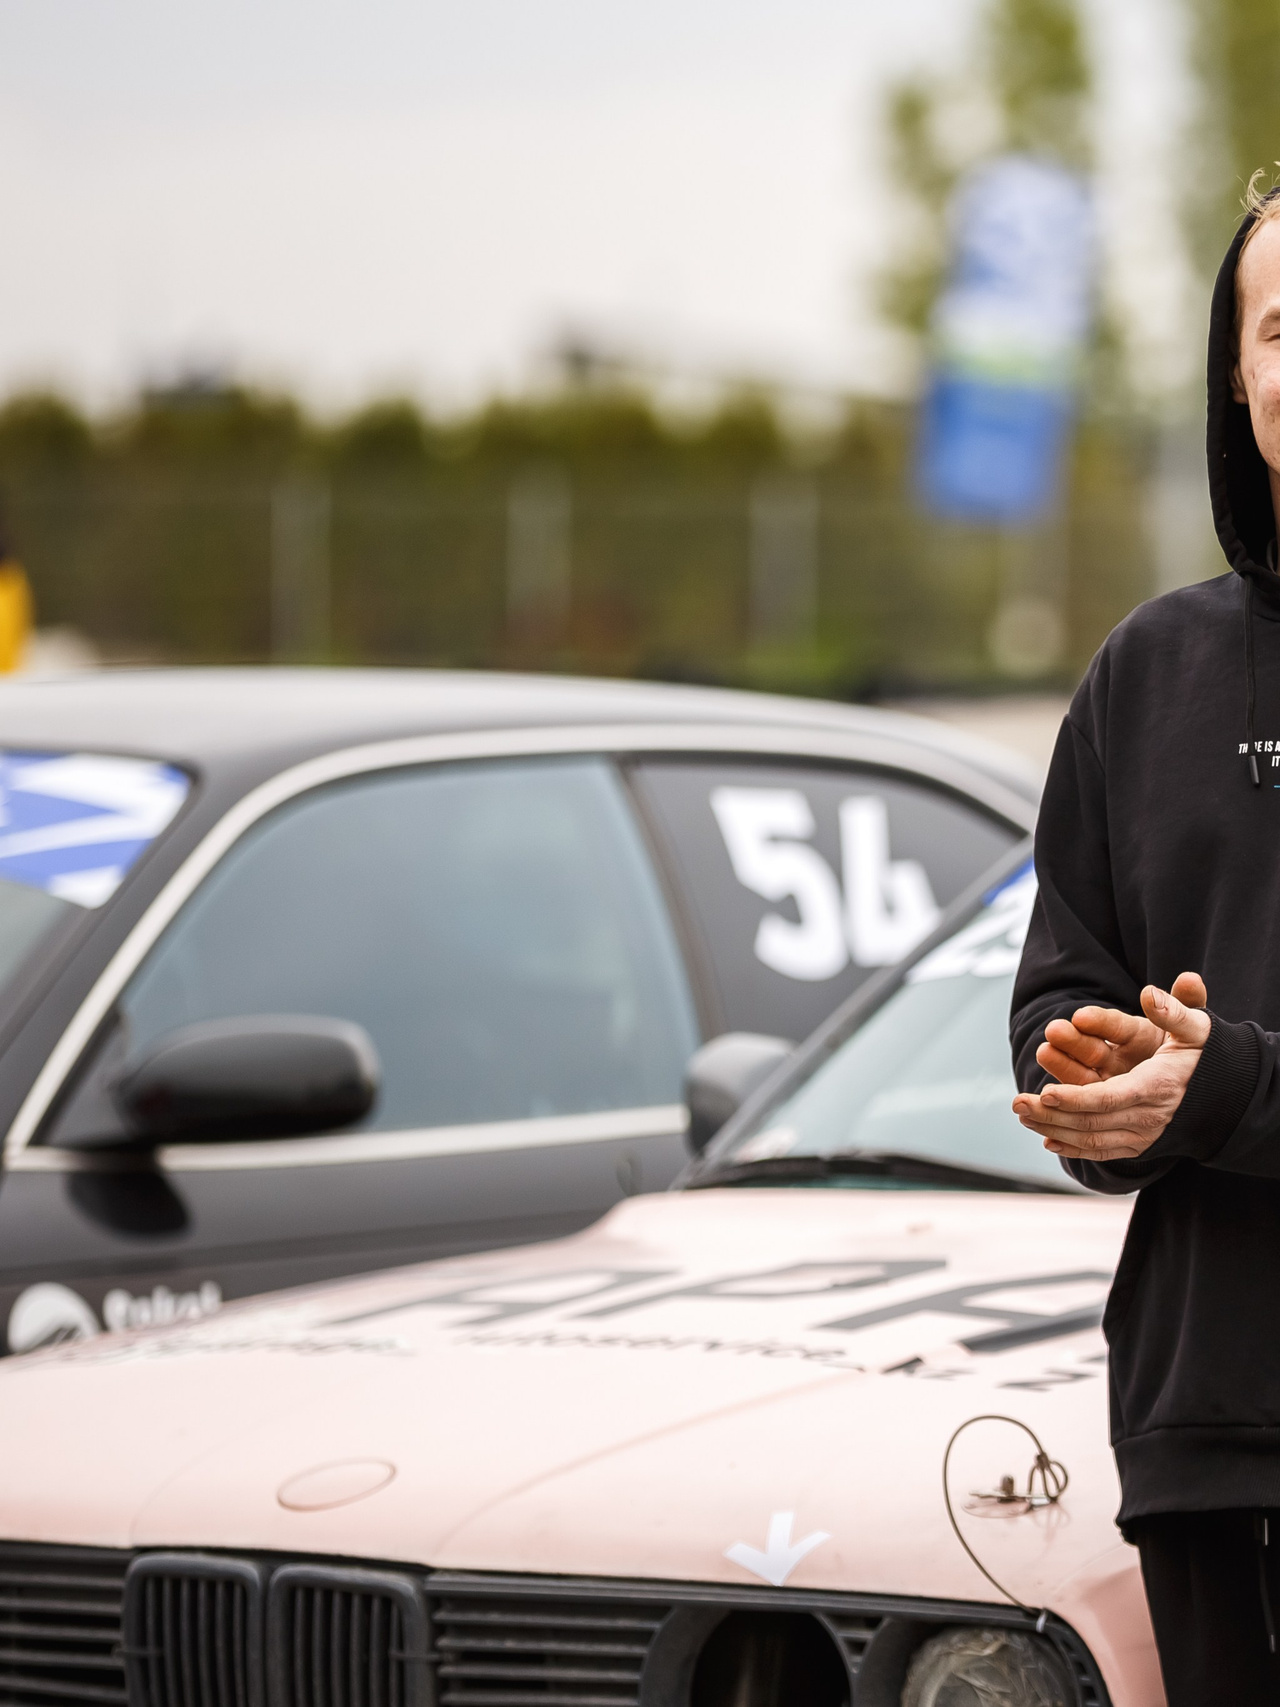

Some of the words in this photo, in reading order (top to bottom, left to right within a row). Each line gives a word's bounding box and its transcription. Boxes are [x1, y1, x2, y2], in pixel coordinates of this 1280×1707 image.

[1239, 741, 1263, 754] THE
[1264, 741, 1273, 752] IS
[1275, 741, 1280, 752] A
[1272, 755, 1280, 767] IT
